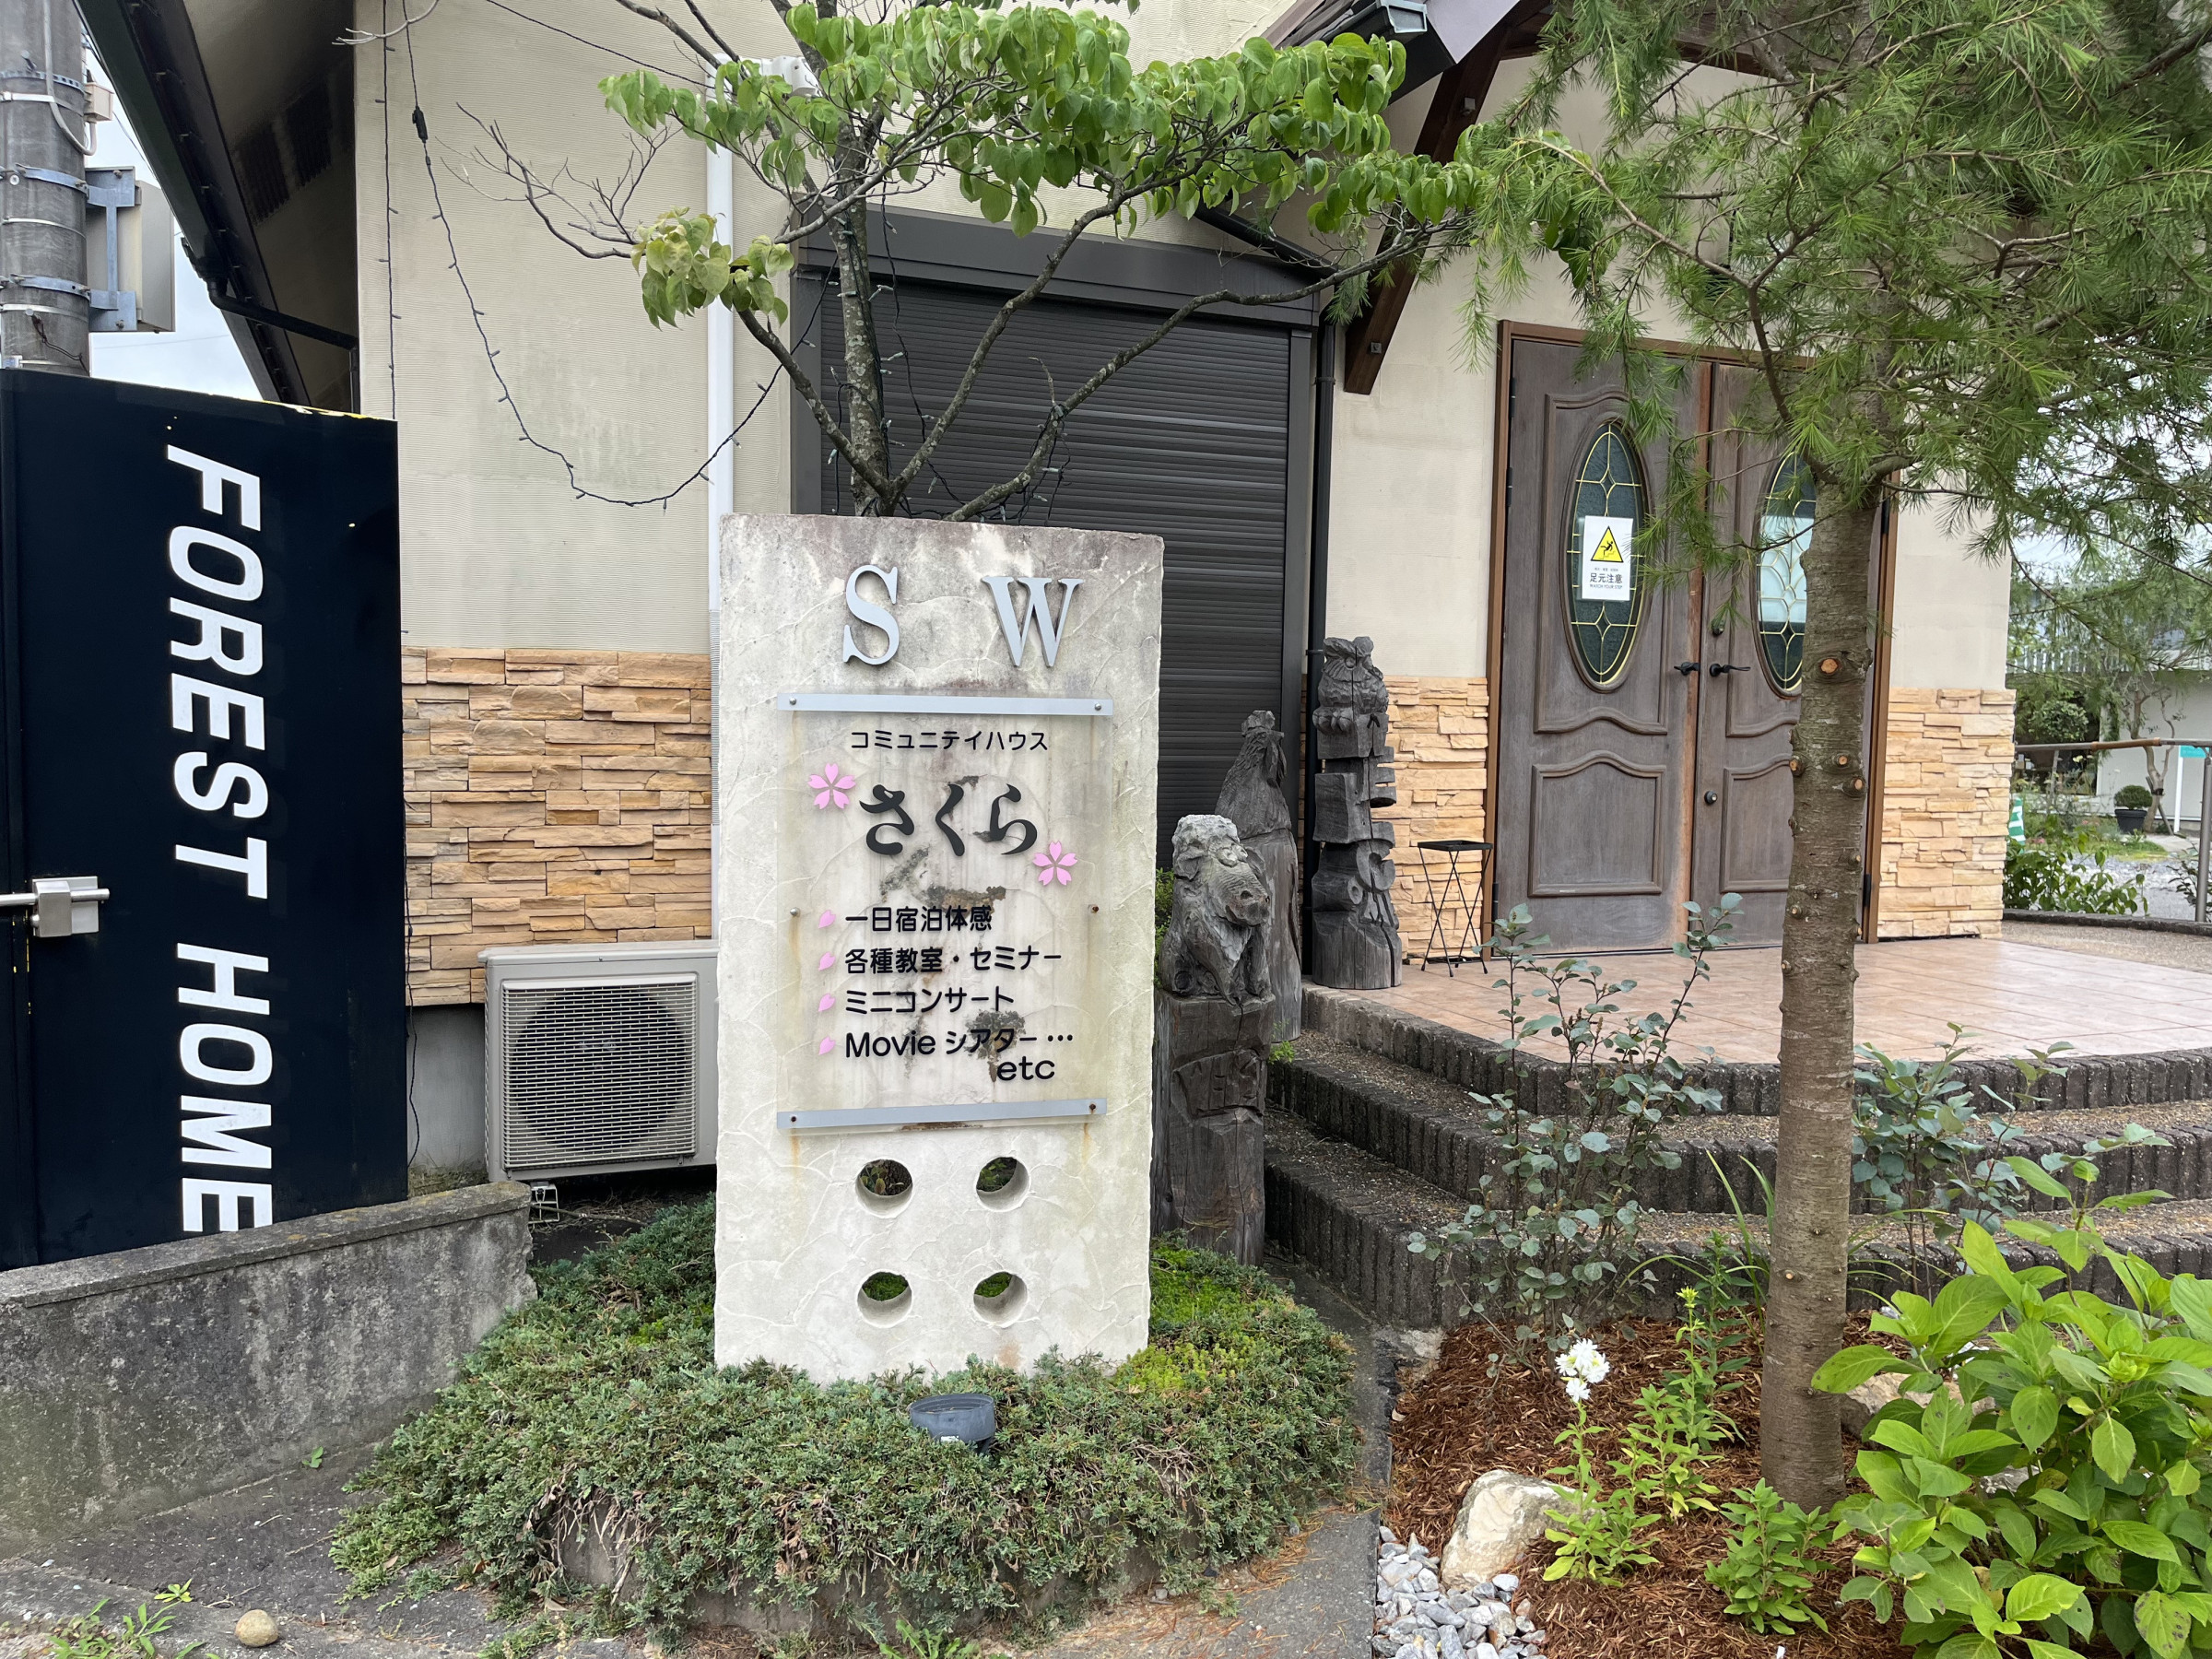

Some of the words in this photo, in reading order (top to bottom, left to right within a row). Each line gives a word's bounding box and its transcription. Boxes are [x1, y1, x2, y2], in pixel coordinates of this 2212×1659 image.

[1590, 572, 1623, 583] 足元注意
[842, 564, 900, 665] S
[982, 576, 1084, 667] W
[167, 444, 269, 900] FOREST
[859, 782, 1038, 857] さくら
[845, 904, 993, 933] 一日宿泊体感
[844, 945, 1062, 974] 各種教室・セミナー
[845, 985, 1015, 1015] ミニコンサート
[996, 1056, 1056, 1081] etc
[177, 943, 273, 1233] HOME
